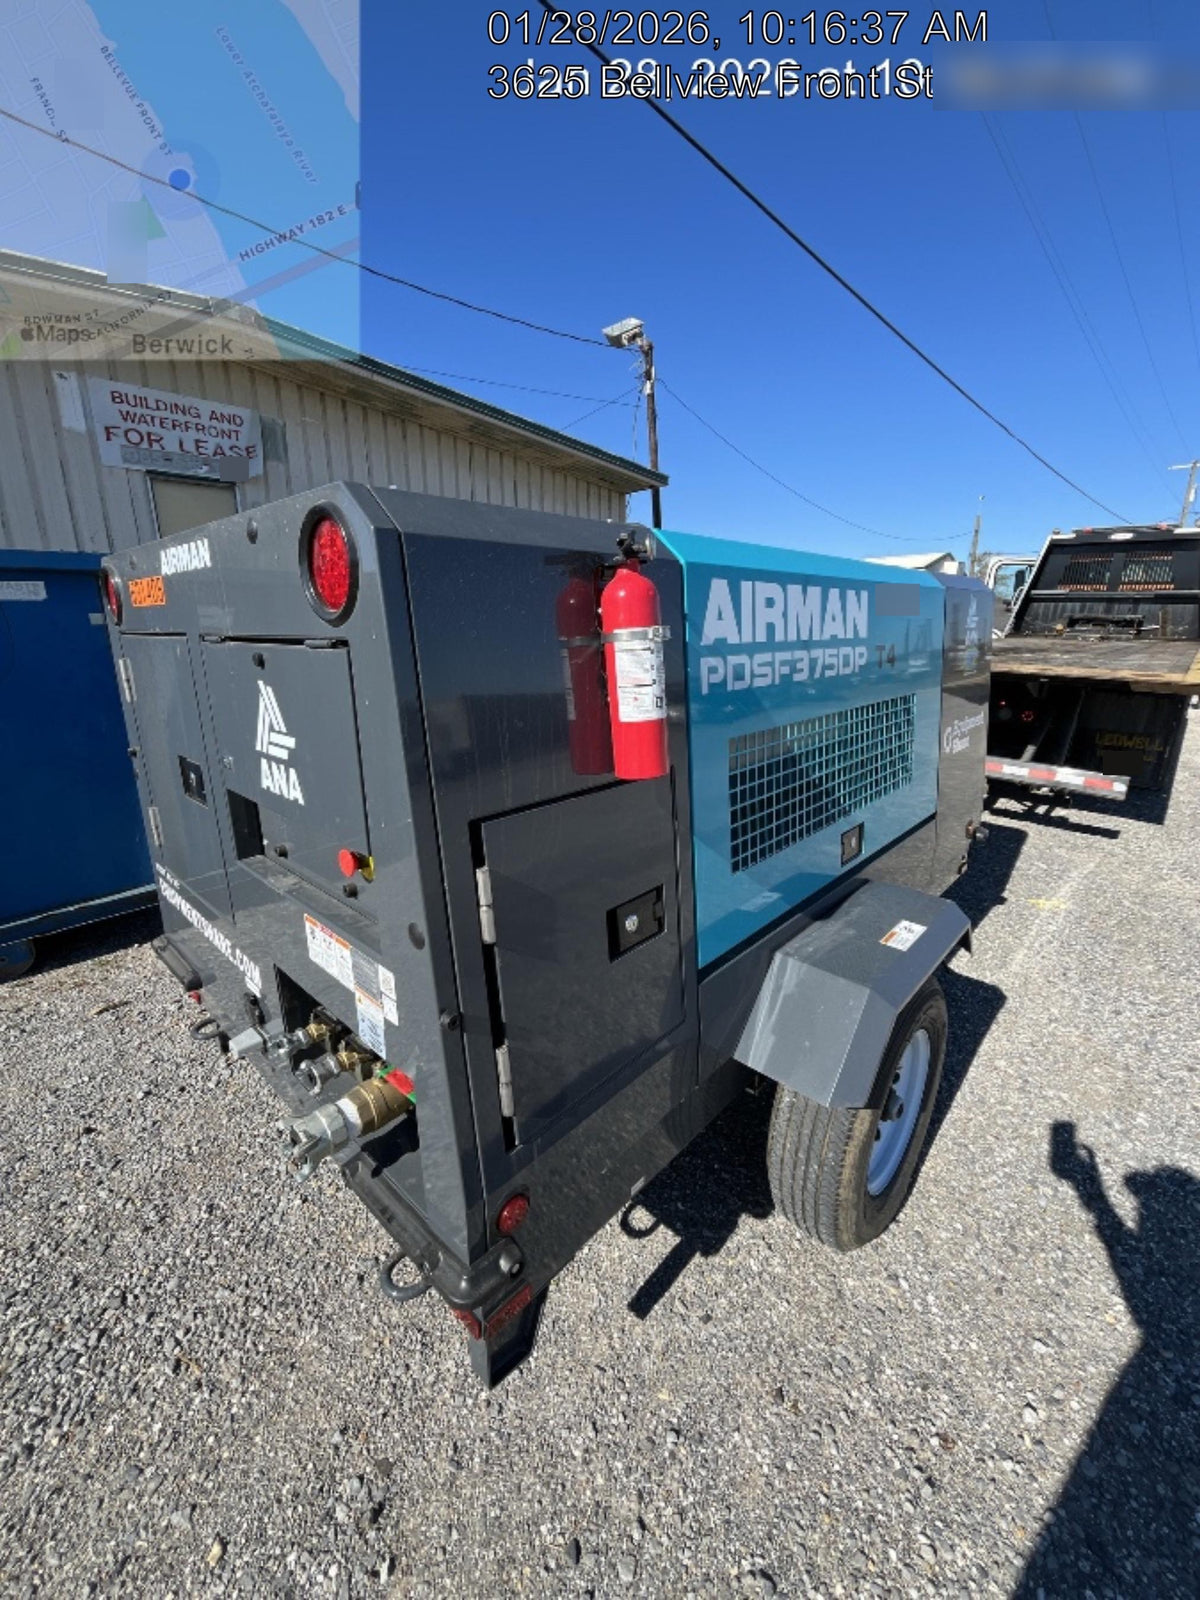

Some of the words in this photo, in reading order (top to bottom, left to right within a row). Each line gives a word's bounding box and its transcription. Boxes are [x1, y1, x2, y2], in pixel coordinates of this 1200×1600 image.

[110, 390, 202, 419] BUILDING
[208, 409, 244, 428] AND
[118, 409, 241, 441] WATERFRONT
[104, 425, 166, 450] FOR
[178, 436, 257, 460] LEASE
[160, 537, 212, 576] AIRMAN
[700, 577, 868, 646] AIRMAN
[700, 645, 868, 695] PDSF375DP
[875, 644, 897, 669] T4
[261, 758, 305, 805] ANA
